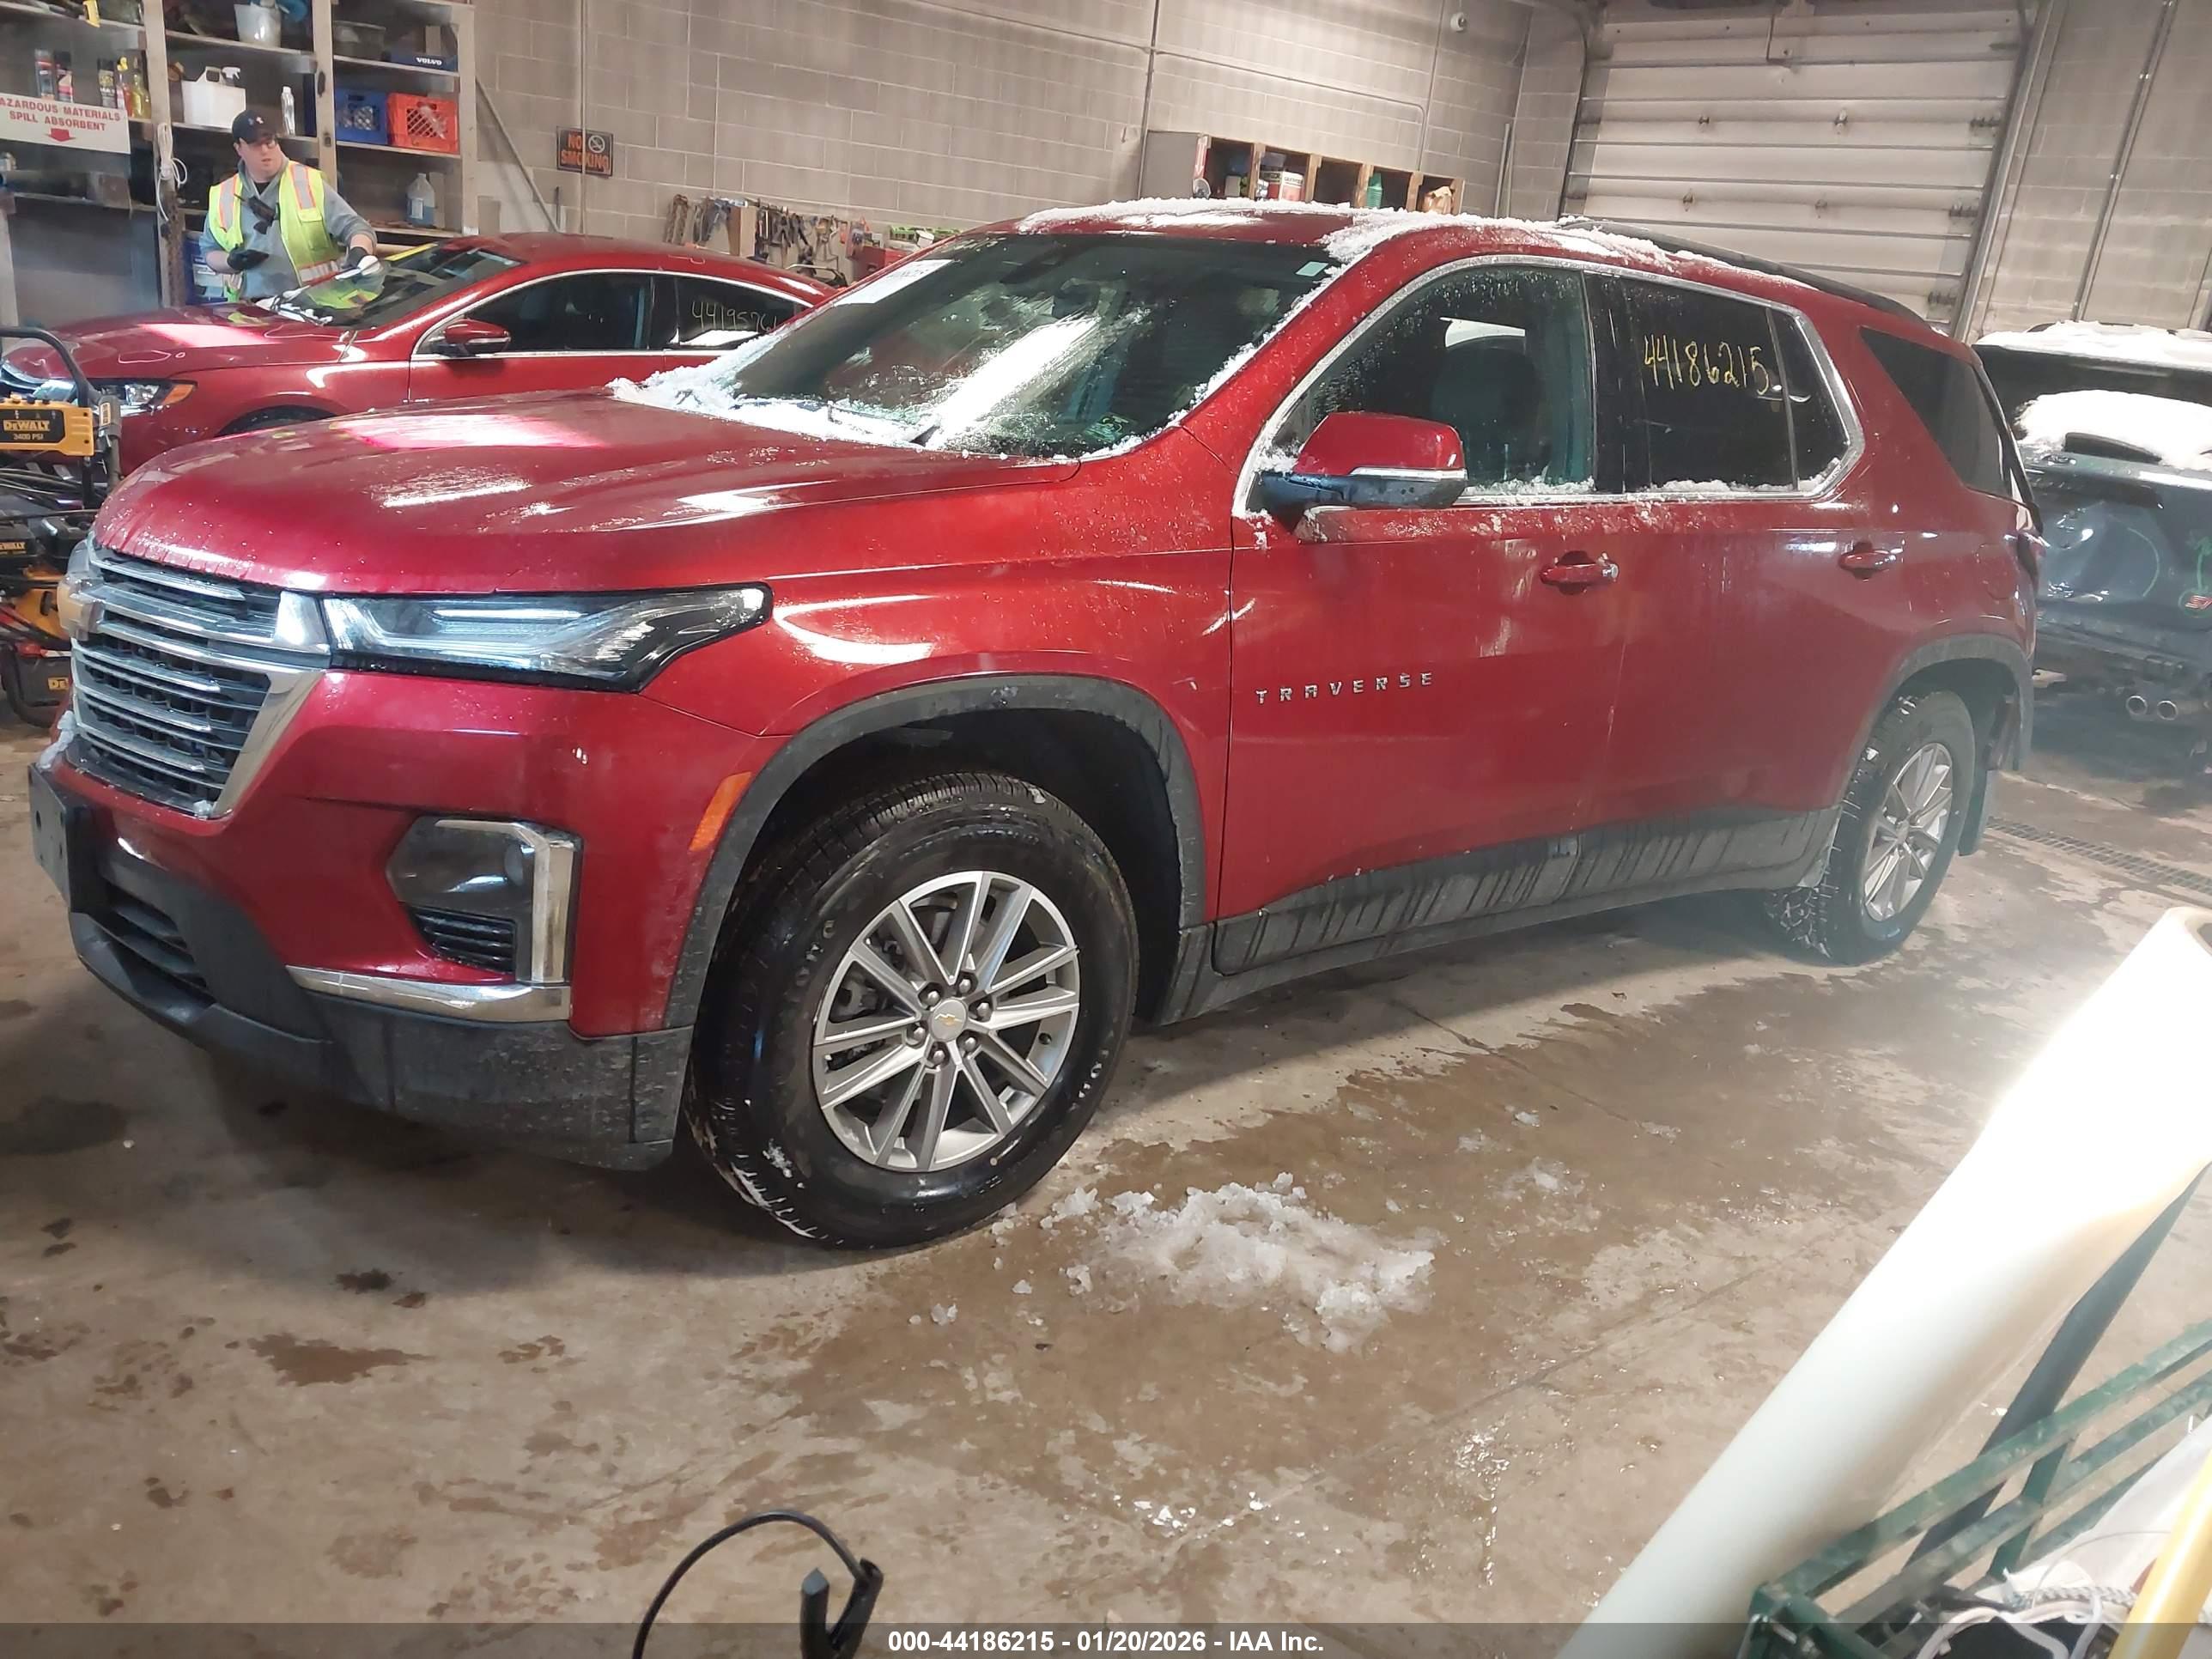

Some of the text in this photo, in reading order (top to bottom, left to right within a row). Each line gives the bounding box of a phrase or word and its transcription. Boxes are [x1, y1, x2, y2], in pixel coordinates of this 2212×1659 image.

[415, 57, 443, 66] VOLVO
[0, 97, 120, 121] AZARDOUS MATERIALS
[9, 111, 106, 131] SPILL ABSORBENT
[568, 133, 582, 149] NO
[561, 149, 610, 173] SMOKING
[1644, 334, 1770, 395] 44186215
[1255, 672, 1432, 704] TRAVERSE
